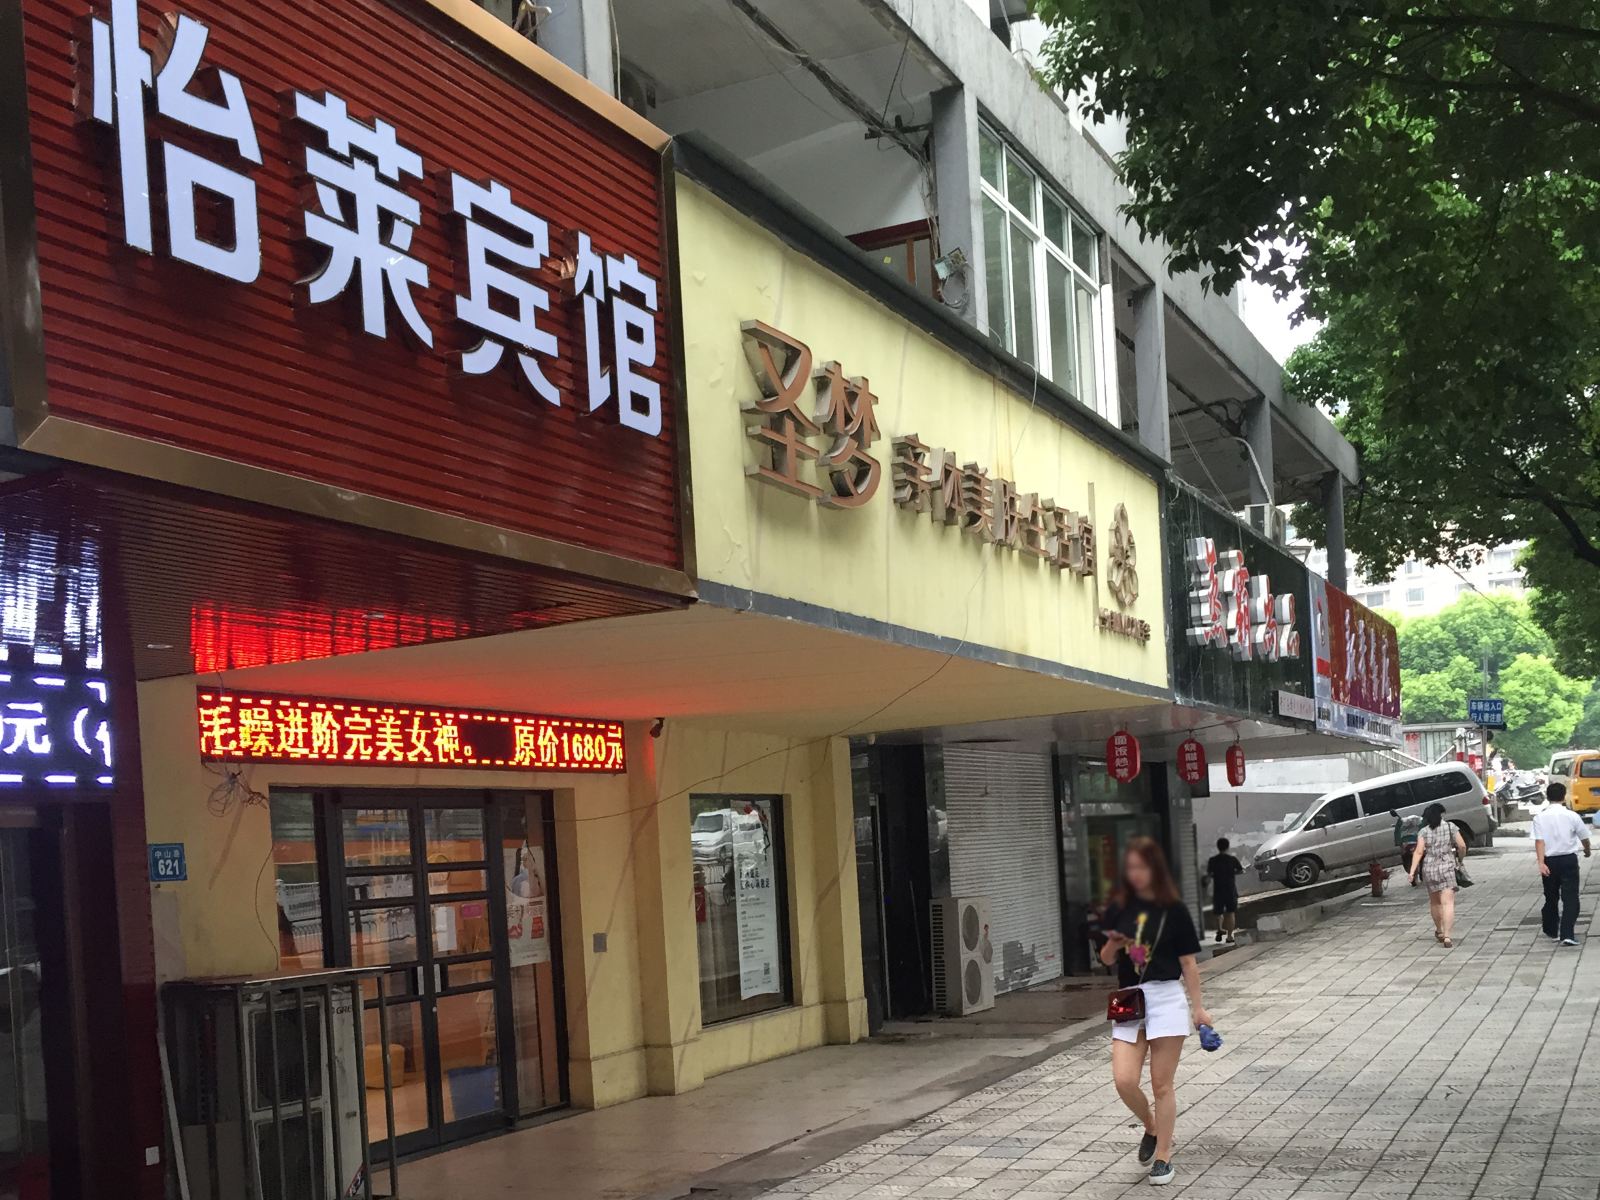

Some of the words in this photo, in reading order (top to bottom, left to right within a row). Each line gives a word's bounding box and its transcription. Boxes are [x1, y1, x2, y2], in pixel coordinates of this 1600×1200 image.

[92, 0, 663, 437] 怡莱宾馆
[740, 318, 882, 511] 圣梦
[1471, 701, 1502, 711] 车辆出入口
[514, 724, 623, 766] 原价1680元
[158, 859, 179, 875] 621
